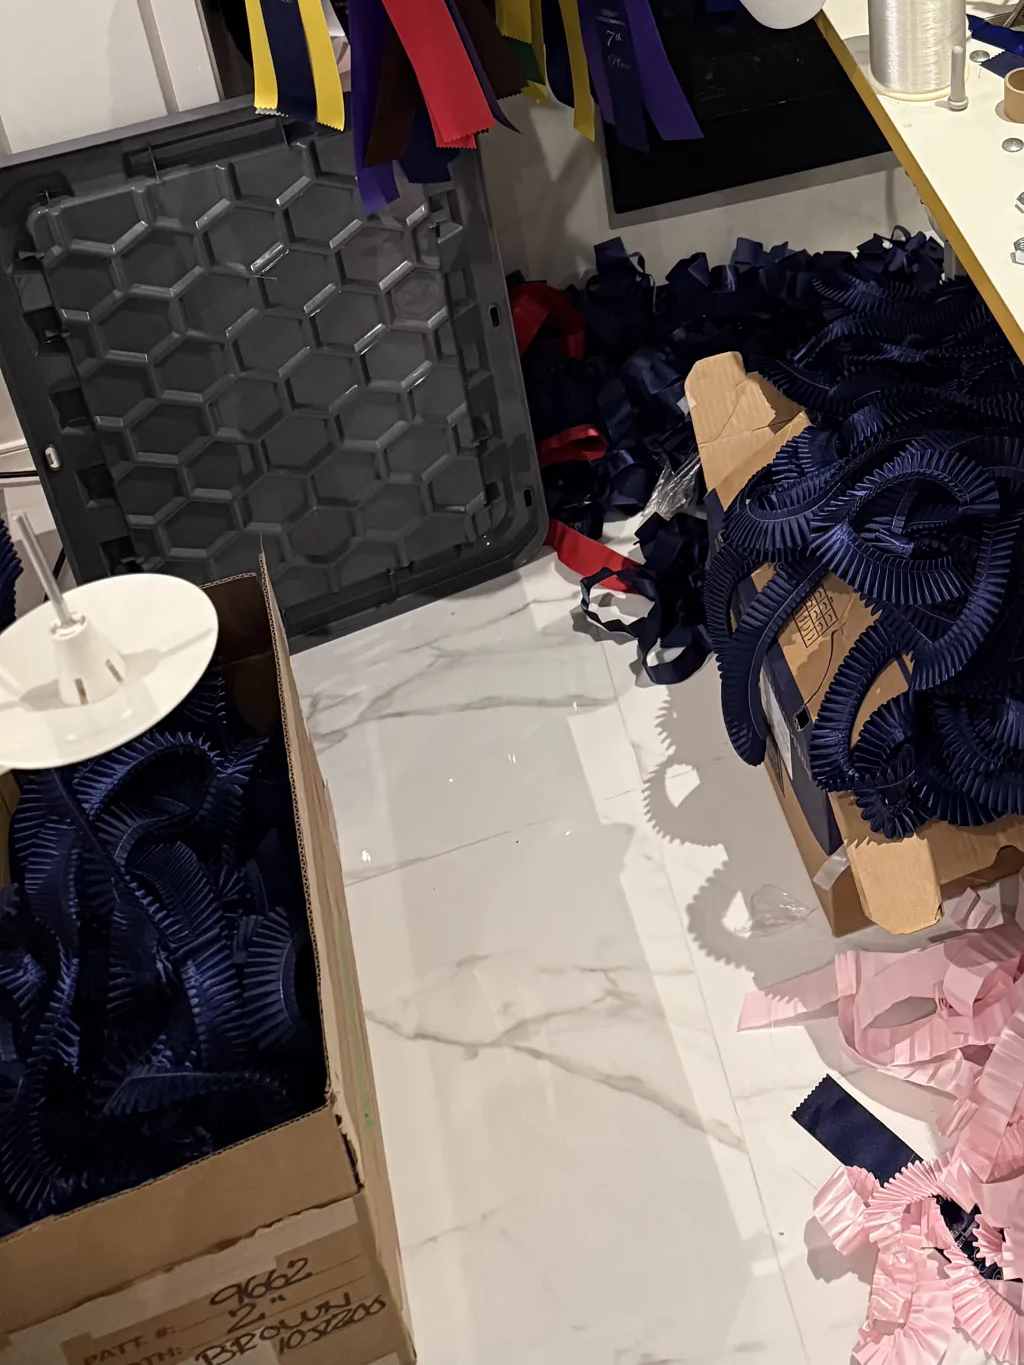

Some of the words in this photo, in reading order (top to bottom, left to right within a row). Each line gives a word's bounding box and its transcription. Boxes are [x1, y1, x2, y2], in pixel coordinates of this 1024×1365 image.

[606, 29, 623, 47] 7th
[210, 1257, 313, 1306] 9662
[197, 1291, 352, 1365] BROWN
[83, 1334, 148, 1365] PATT.
